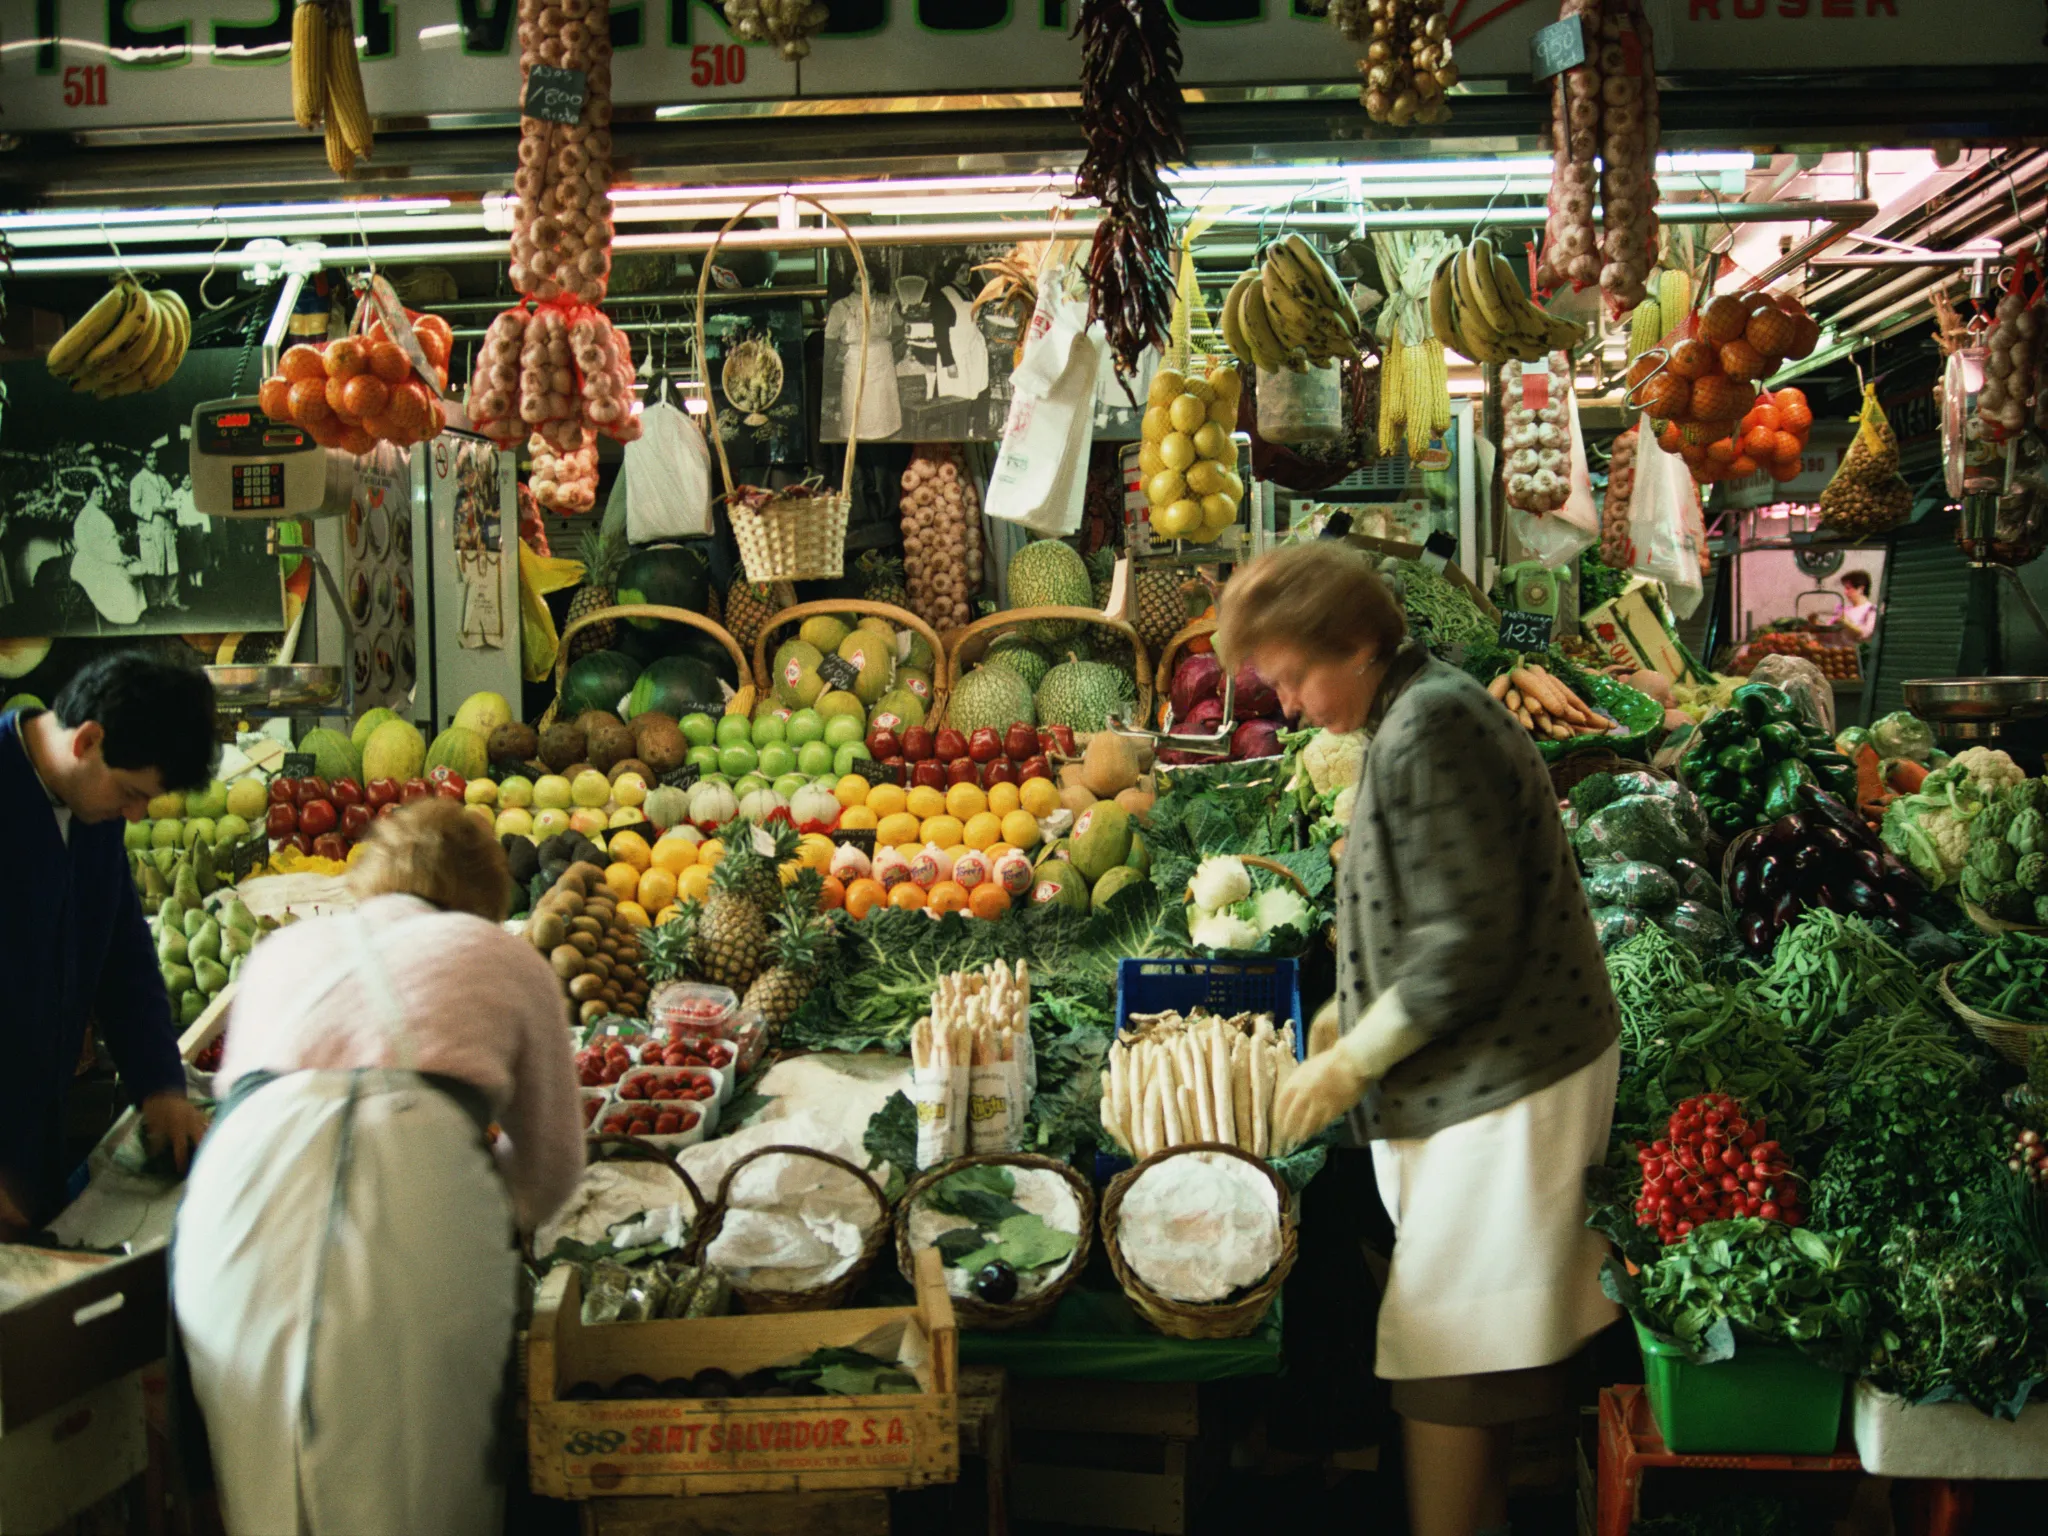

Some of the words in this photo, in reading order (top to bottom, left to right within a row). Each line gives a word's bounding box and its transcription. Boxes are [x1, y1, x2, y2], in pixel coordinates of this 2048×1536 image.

[690, 44, 746, 87] 510
[64, 65, 108, 107] 511
[1501, 623, 1544, 643] 125
[629, 1424, 704, 1455] SANT
